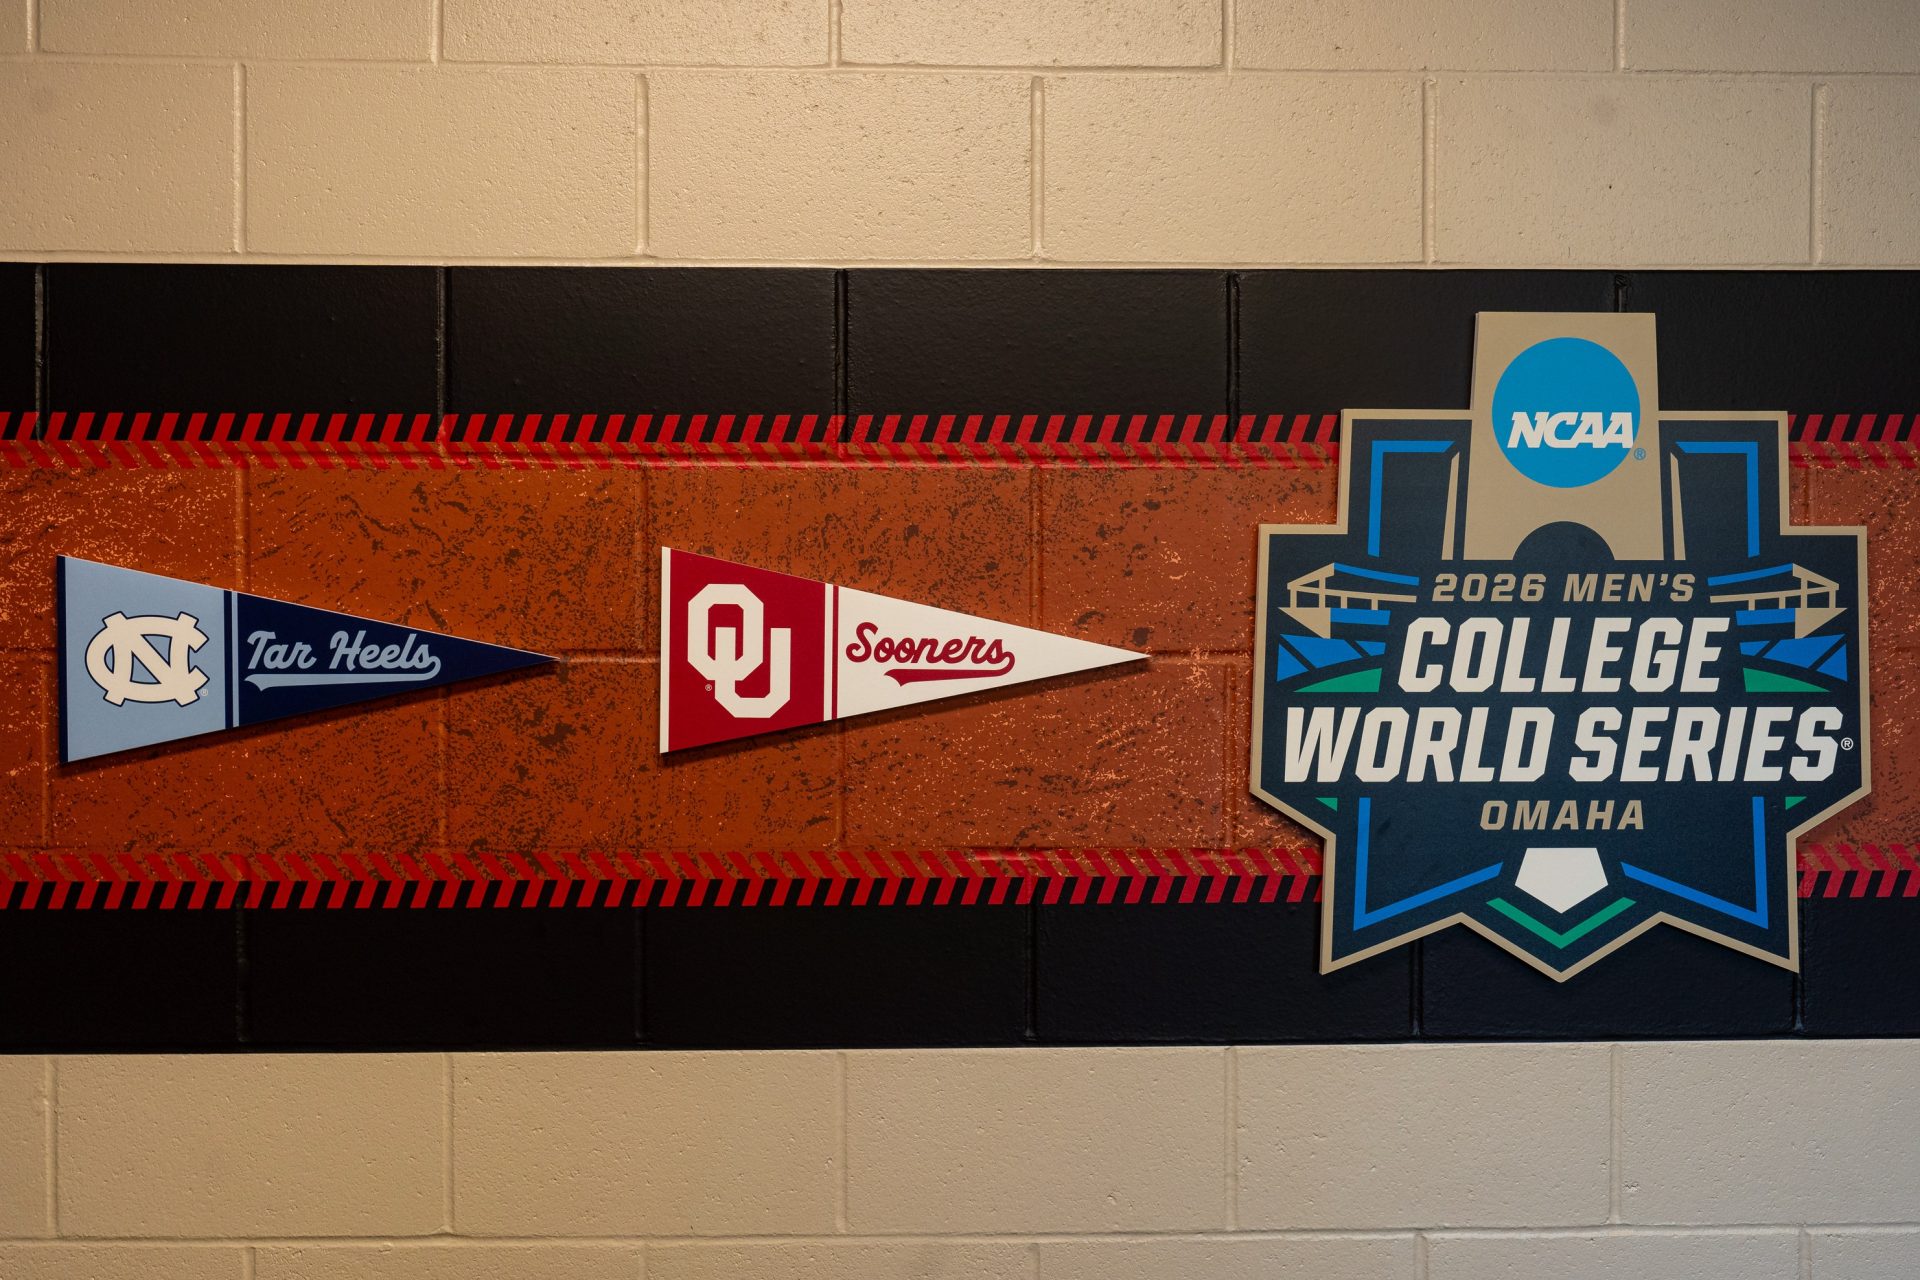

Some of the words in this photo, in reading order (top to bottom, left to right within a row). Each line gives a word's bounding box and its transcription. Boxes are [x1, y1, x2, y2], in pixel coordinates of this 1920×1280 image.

[1507, 411, 1634, 449] NCAA
[1432, 573, 1546, 602] 2026
[1563, 573, 1696, 602] MEN'S
[246, 630, 317, 670] Tar
[329, 630, 442, 677] Heels
[687, 583, 792, 719] OU
[845, 621, 1016, 676] Sooners
[1398, 617, 1730, 693] COLLEGE
[1284, 706, 1556, 783] WORLD
[1479, 799, 1645, 831] OMAHA
